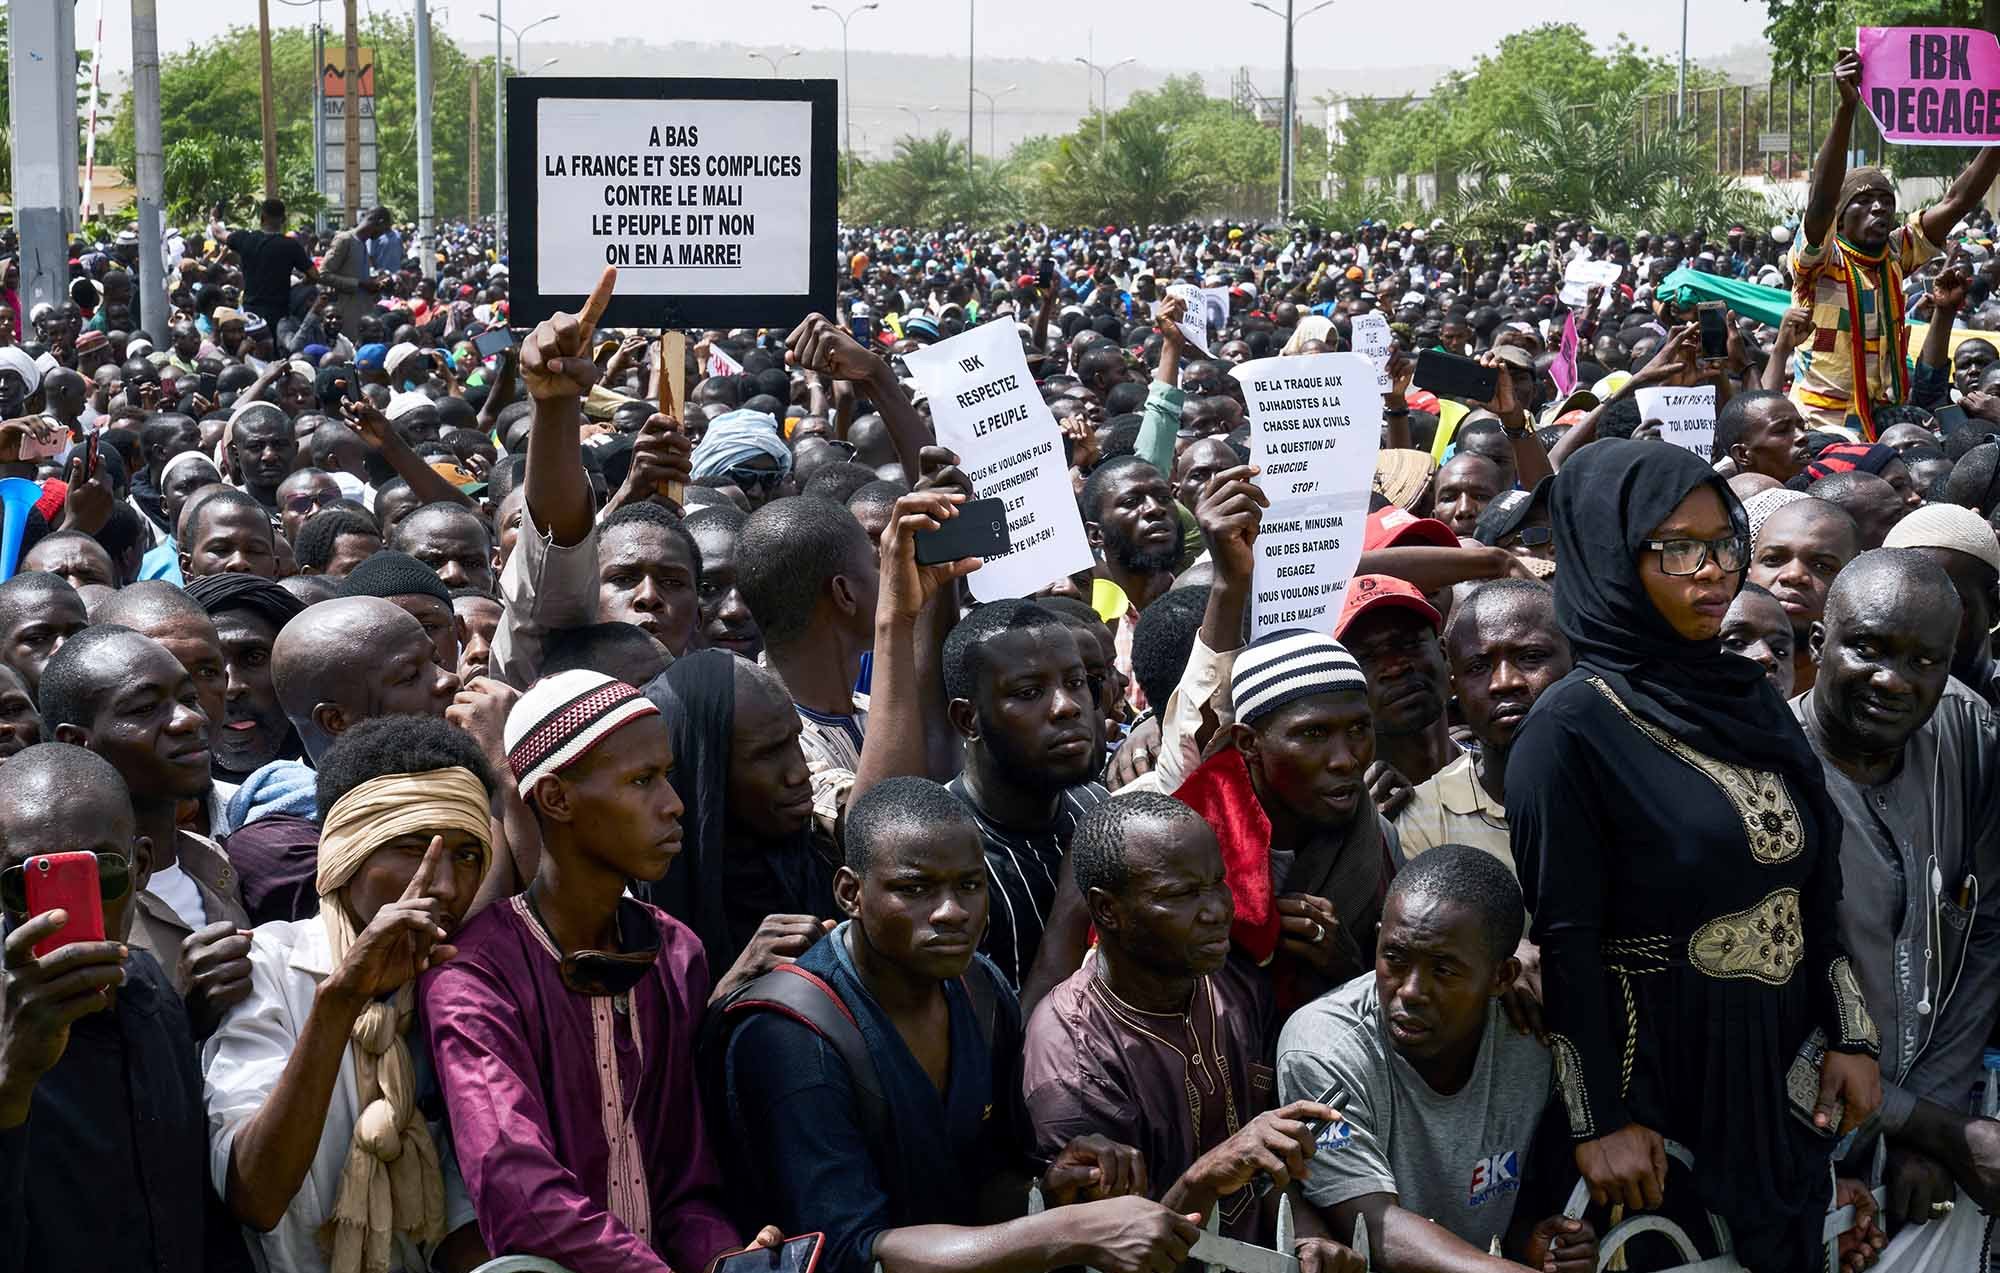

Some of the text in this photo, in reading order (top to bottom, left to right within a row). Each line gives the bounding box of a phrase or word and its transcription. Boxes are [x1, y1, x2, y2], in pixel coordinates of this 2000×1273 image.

[1910, 33, 1972, 80] IBK
[1871, 86, 2000, 135] DEGAGE
[649, 125, 699, 147] A BAS
[545, 155, 801, 177] LA FRANCE ET SES COMPLICES
[604, 184, 743, 206] CONTRE LE MALI
[592, 214, 754, 236] LE PEUPLE DIT NON
[606, 244, 742, 265] ON EN A MARRE!
[958, 354, 984, 374] IBK
[956, 374, 1019, 409] RESPECTEZ
[1254, 376, 1342, 392] DE LA TRAQUE AUX
[1259, 396, 1341, 412] DJIHADISTES A LA
[973, 404, 1029, 438] LE PEUPLE
[1263, 415, 1351, 432] CHASSE AUX CIVILS
[1266, 438, 1336, 455] LA QUESTION DU
[988, 463, 998, 475] NE
[998, 449, 1032, 470] VOULONS
[1032, 441, 1053, 457] PLUS
[1267, 461, 1308, 475] GENOCIDE
[982, 467, 1039, 499] GOUVERNEMENT
[1291, 482, 1314, 493] STOP
[1016, 496, 1025, 508] ET
[1009, 512, 1036, 532] NSABLE
[1259, 516, 1343, 535] ARKHANE, MINUSMA
[1266, 539, 1340, 557] QUE DES BATARDS
[1277, 564, 1316, 578] DEGAGEZ
[1258, 590, 1279, 604] NOUS
[1281, 585, 1319, 600] VOULONS
[1321, 583, 1331, 595] UN
[1258, 612, 1279, 626] POUR
[1281, 610, 1296, 623] LES
